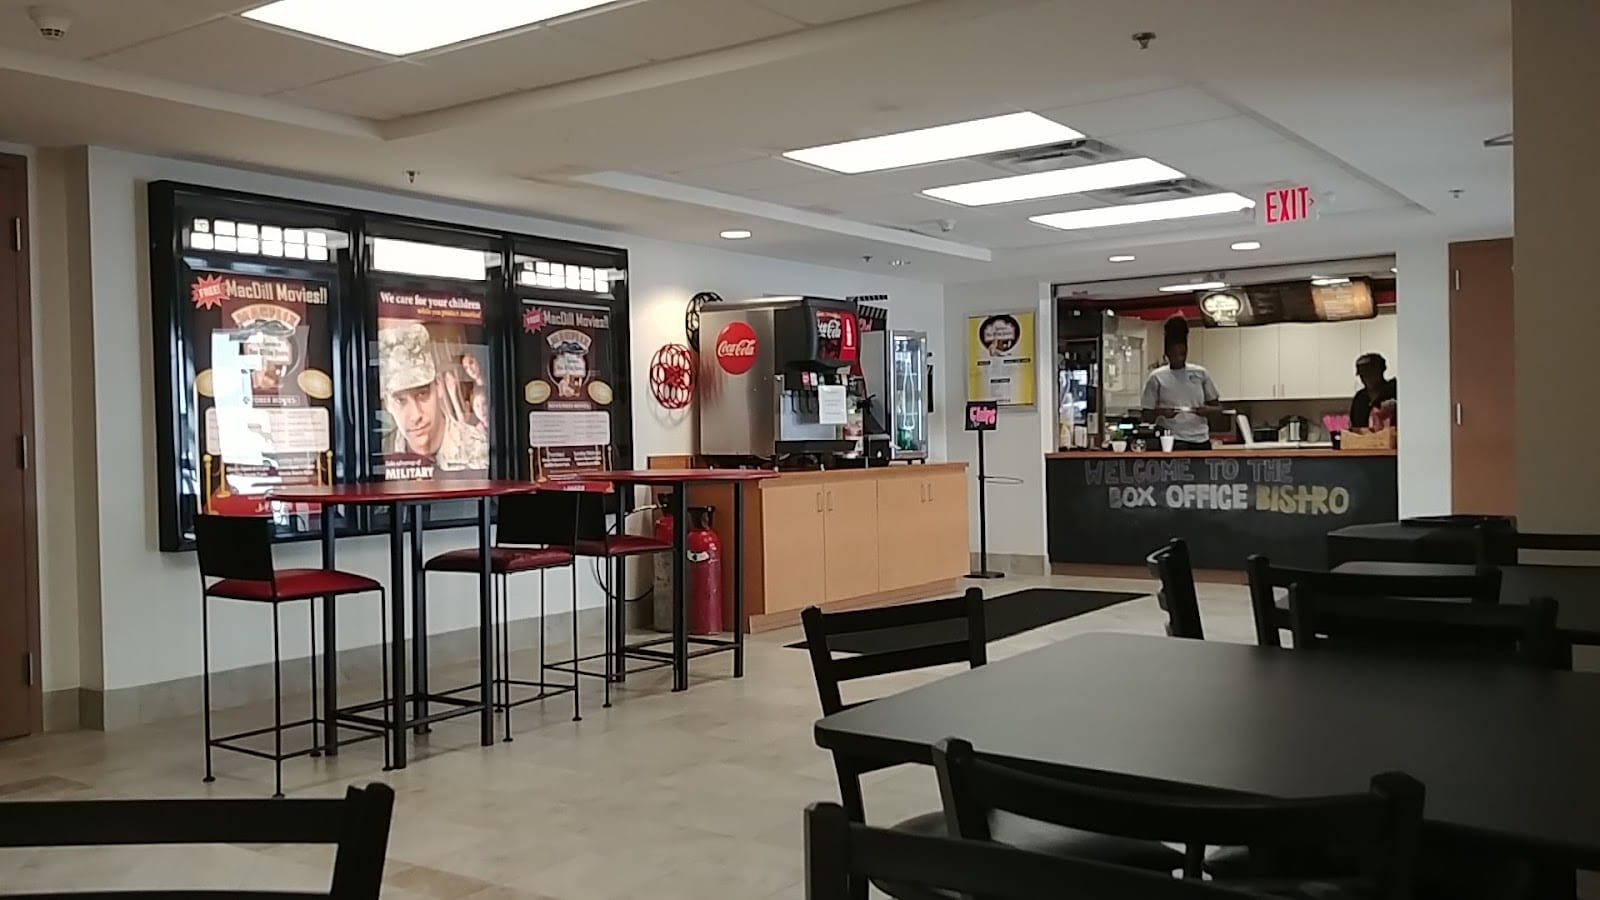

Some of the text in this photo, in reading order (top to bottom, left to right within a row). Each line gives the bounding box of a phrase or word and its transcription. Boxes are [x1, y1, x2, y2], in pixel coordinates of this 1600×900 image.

[1265, 186, 1309, 223] EXIT
[225, 279, 328, 304] MacDill Movies!!
[380, 291, 481, 310] We care for your children
[544, 310, 574, 326] MacDill
[717, 339, 756, 357] Coca-Cola
[385, 466, 434, 480] MILITARY
[1084, 458, 1294, 485] WELCOME TO THE
[1109, 486, 1157, 509] BOX
[1165, 484, 1249, 510] OFFICE
